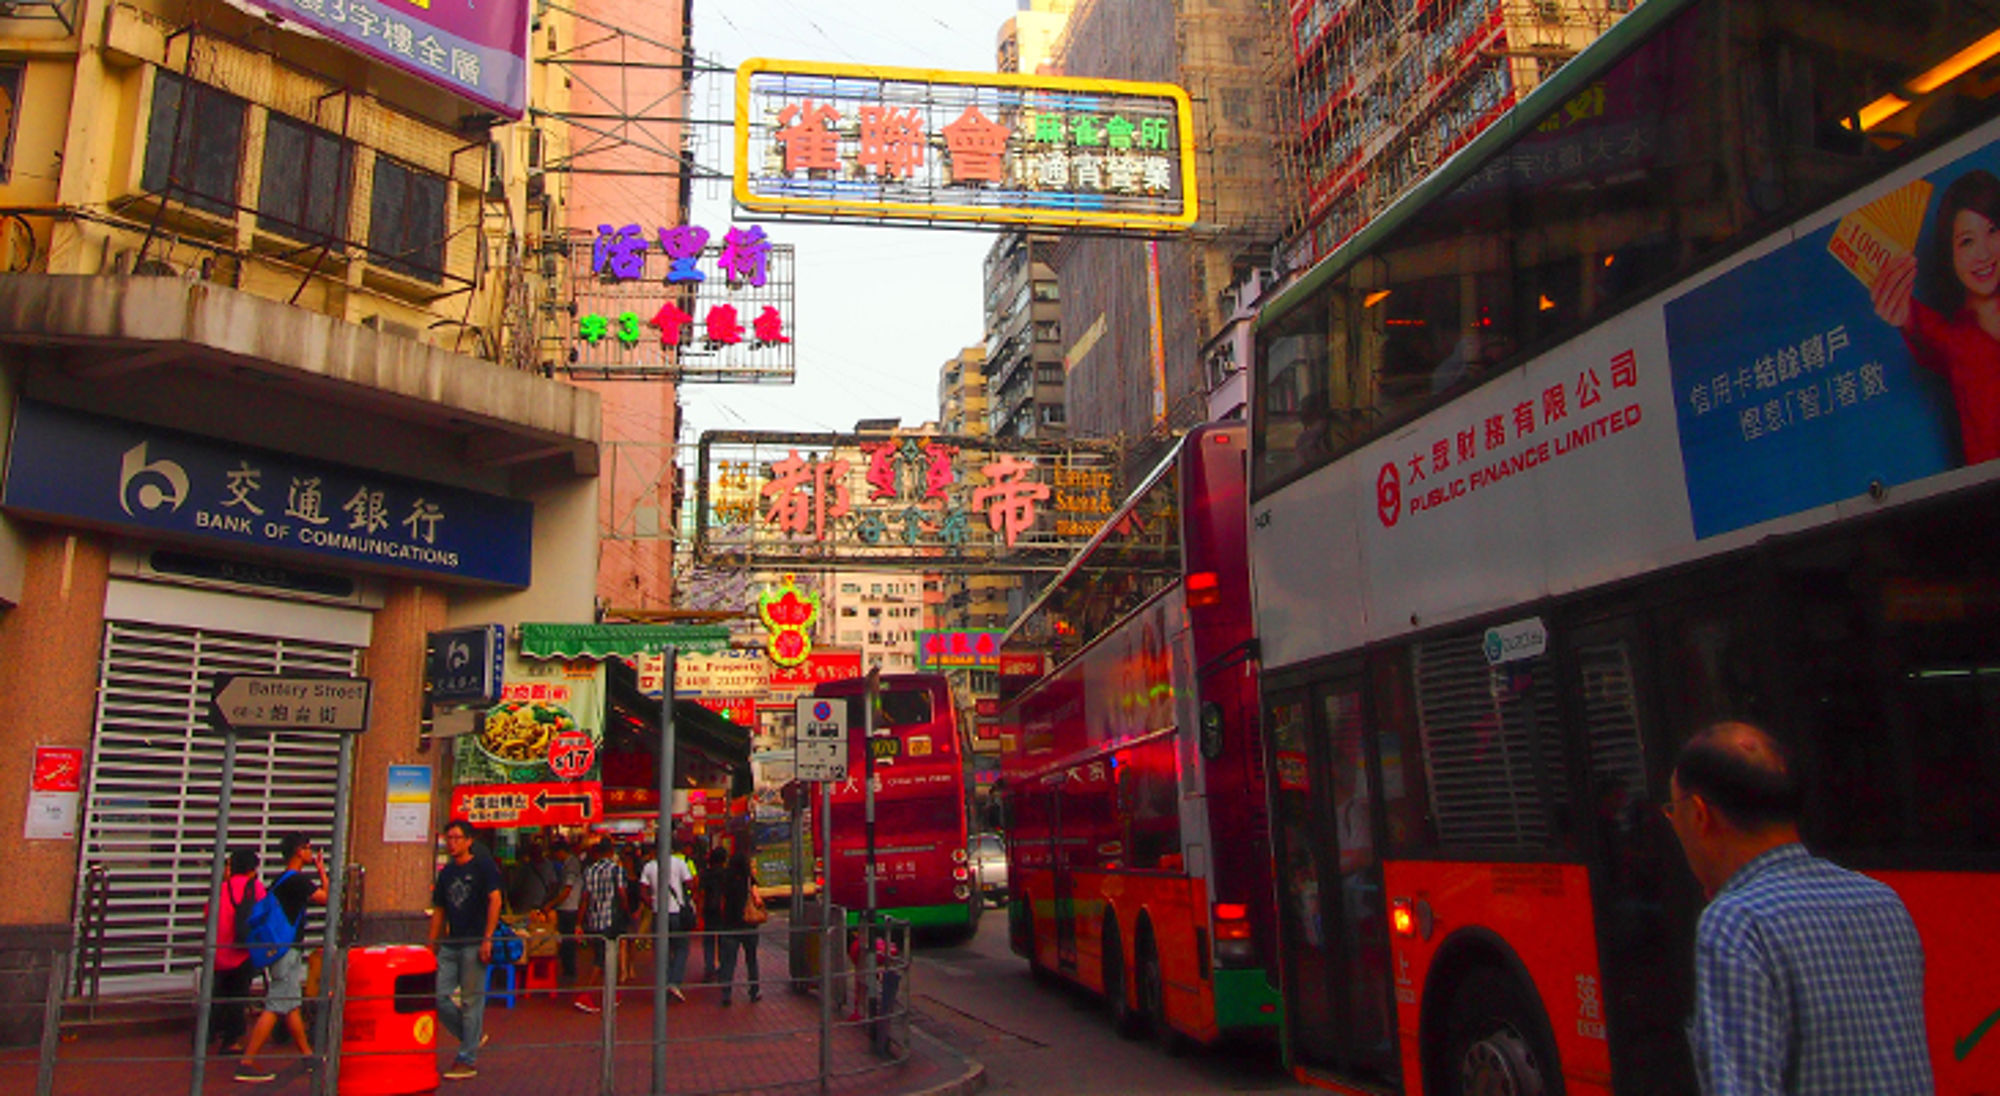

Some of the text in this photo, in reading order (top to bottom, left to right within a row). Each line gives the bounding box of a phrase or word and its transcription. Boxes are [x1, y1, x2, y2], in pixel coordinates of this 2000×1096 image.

[775, 99, 1011, 182] 雀聯會
[1034, 113, 1168, 150] 麻雀會所
[1408, 348, 1638, 485] 大眾財務有限公司
[973, 454, 1050, 547] 帝
[1410, 403, 1642, 516] PUBLIC FINANCE LIMITED
[196, 510, 459, 568] BANK OF COMMUNICATIONS
[220, 460, 445, 544] 交通銀行
[249, 681, 363, 700] Battery Street
[555, 750, 589, 769] $17
